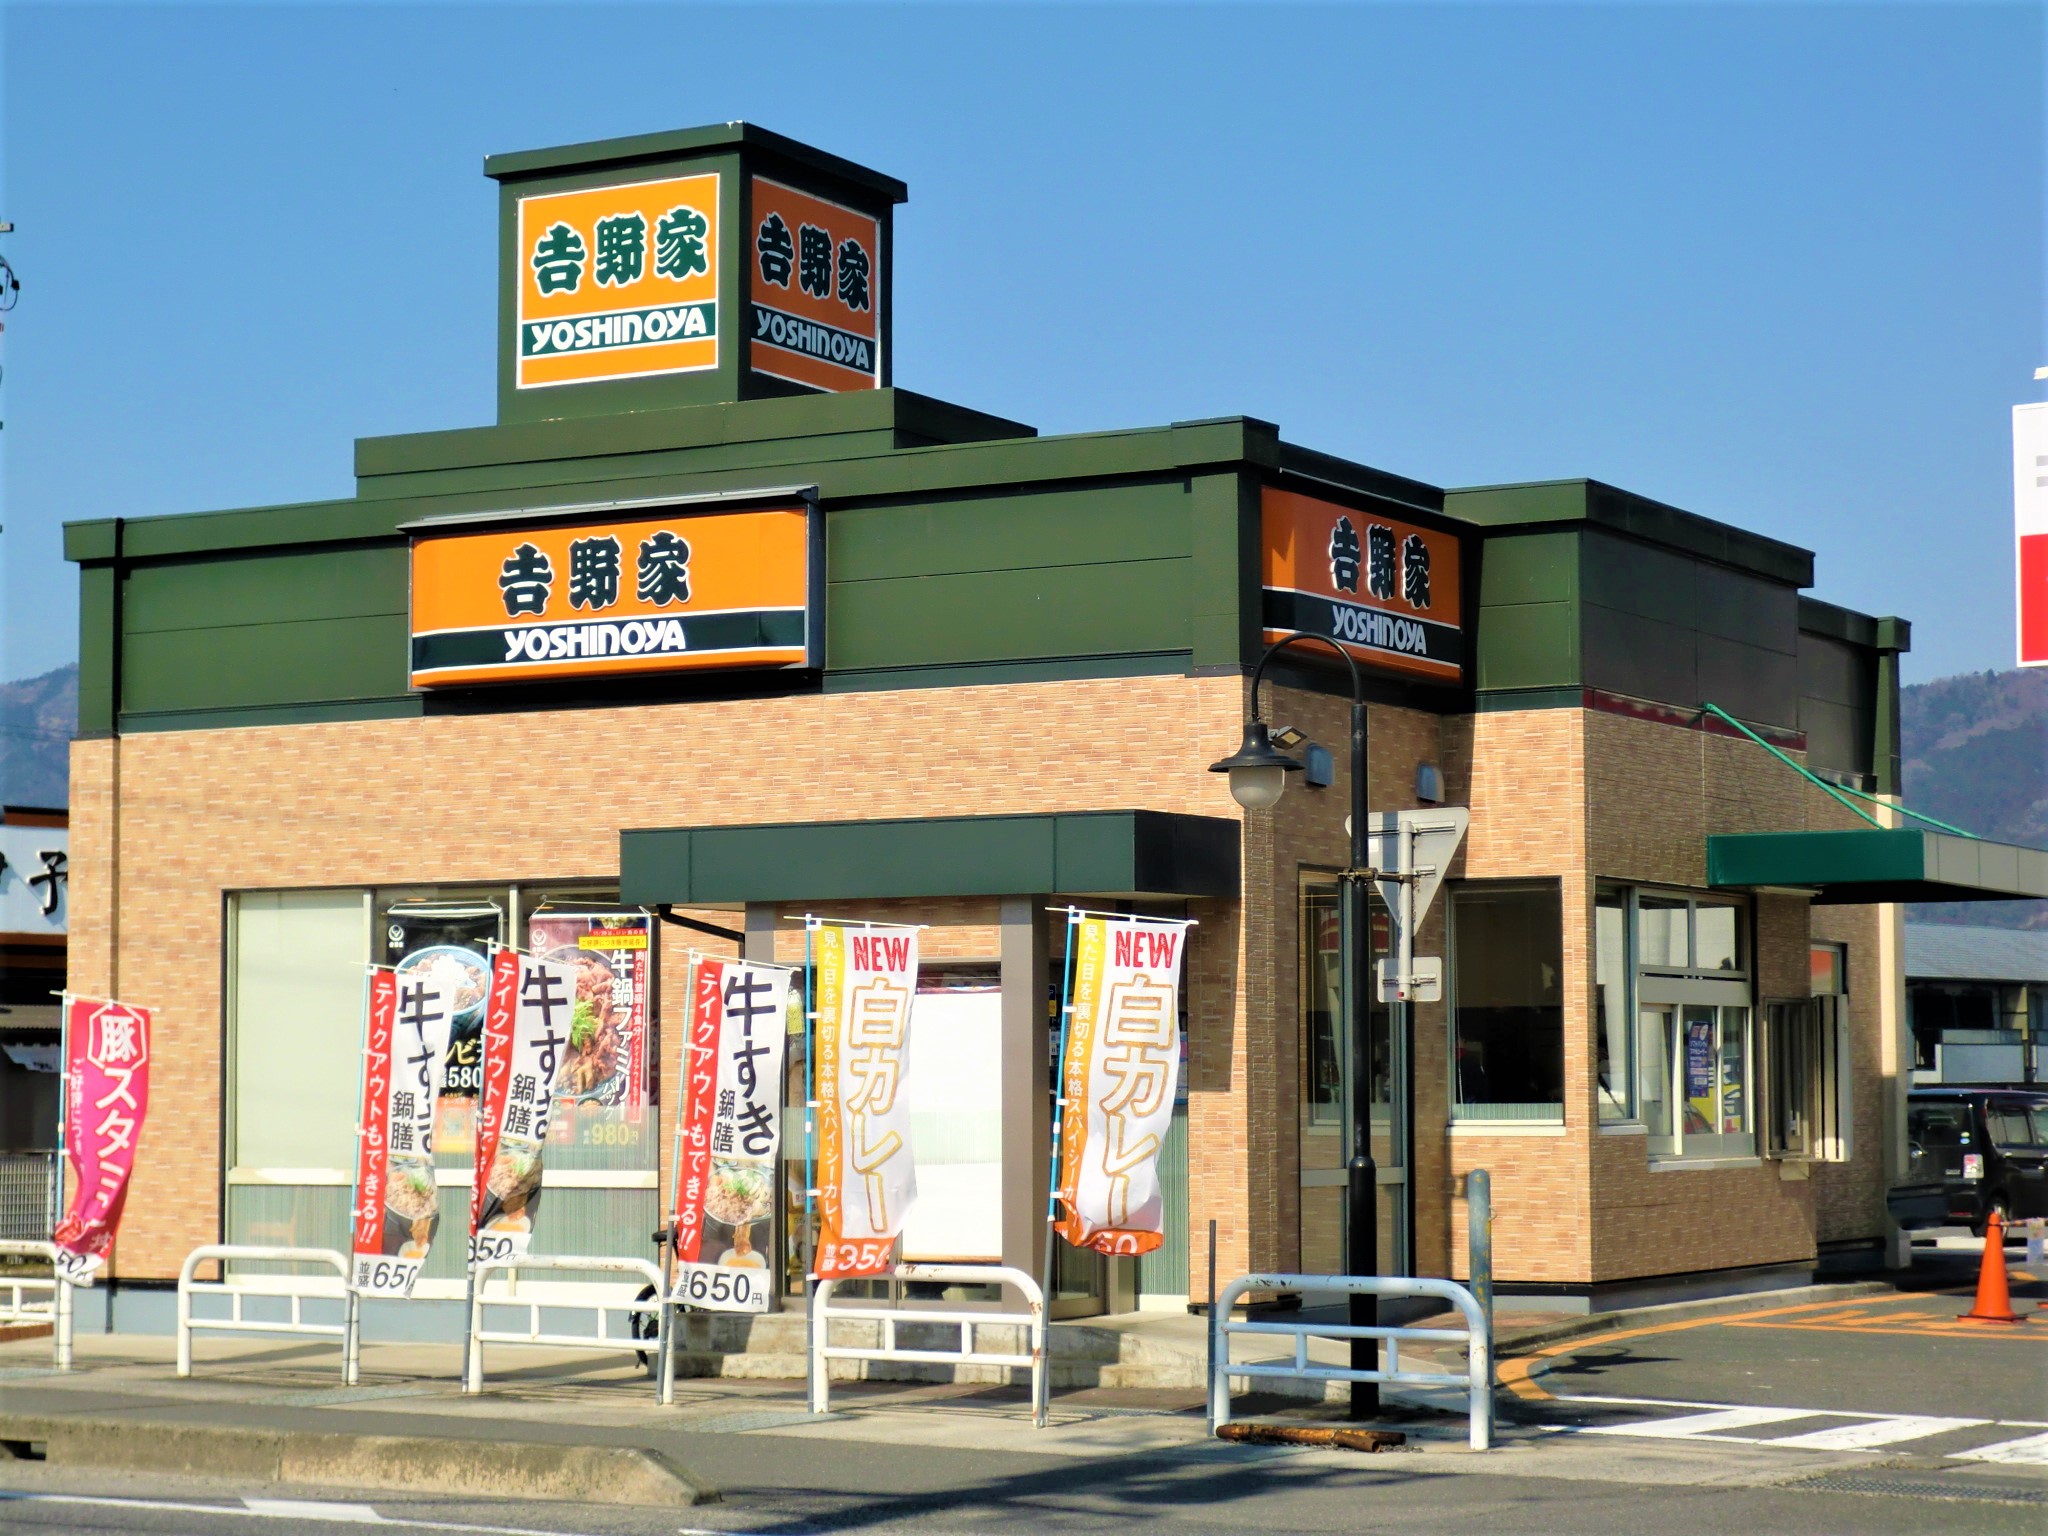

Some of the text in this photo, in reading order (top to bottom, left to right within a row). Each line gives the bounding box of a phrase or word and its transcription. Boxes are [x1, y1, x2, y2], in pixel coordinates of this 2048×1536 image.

[532, 307, 706, 353] YOSHINOYA
[757, 309, 869, 369] YOSHINOYA
[505, 620, 686, 662] YOSHINOYA
[1333, 604, 1426, 654] YOSHINOYA
[853, 936, 910, 972] NEW
[1116, 930, 1177, 968] NEW
[724, 972, 776, 1156] 牛すき
[821, 931, 842, 1231] 見た目を裏切る本格スパイシーカレー
[359, 982, 394, 1244] テイクアウトもできる!!
[391, 1089, 415, 1151] 鍋膳
[504, 1073, 536, 1136] 鍋膳
[679, 972, 718, 1251] テイクアウトもできる!!
[713, 1088, 735, 1154] 鍋膳
[846, 977, 908, 1232] 白カレー
[1100, 973, 1175, 1226] 白カレー
